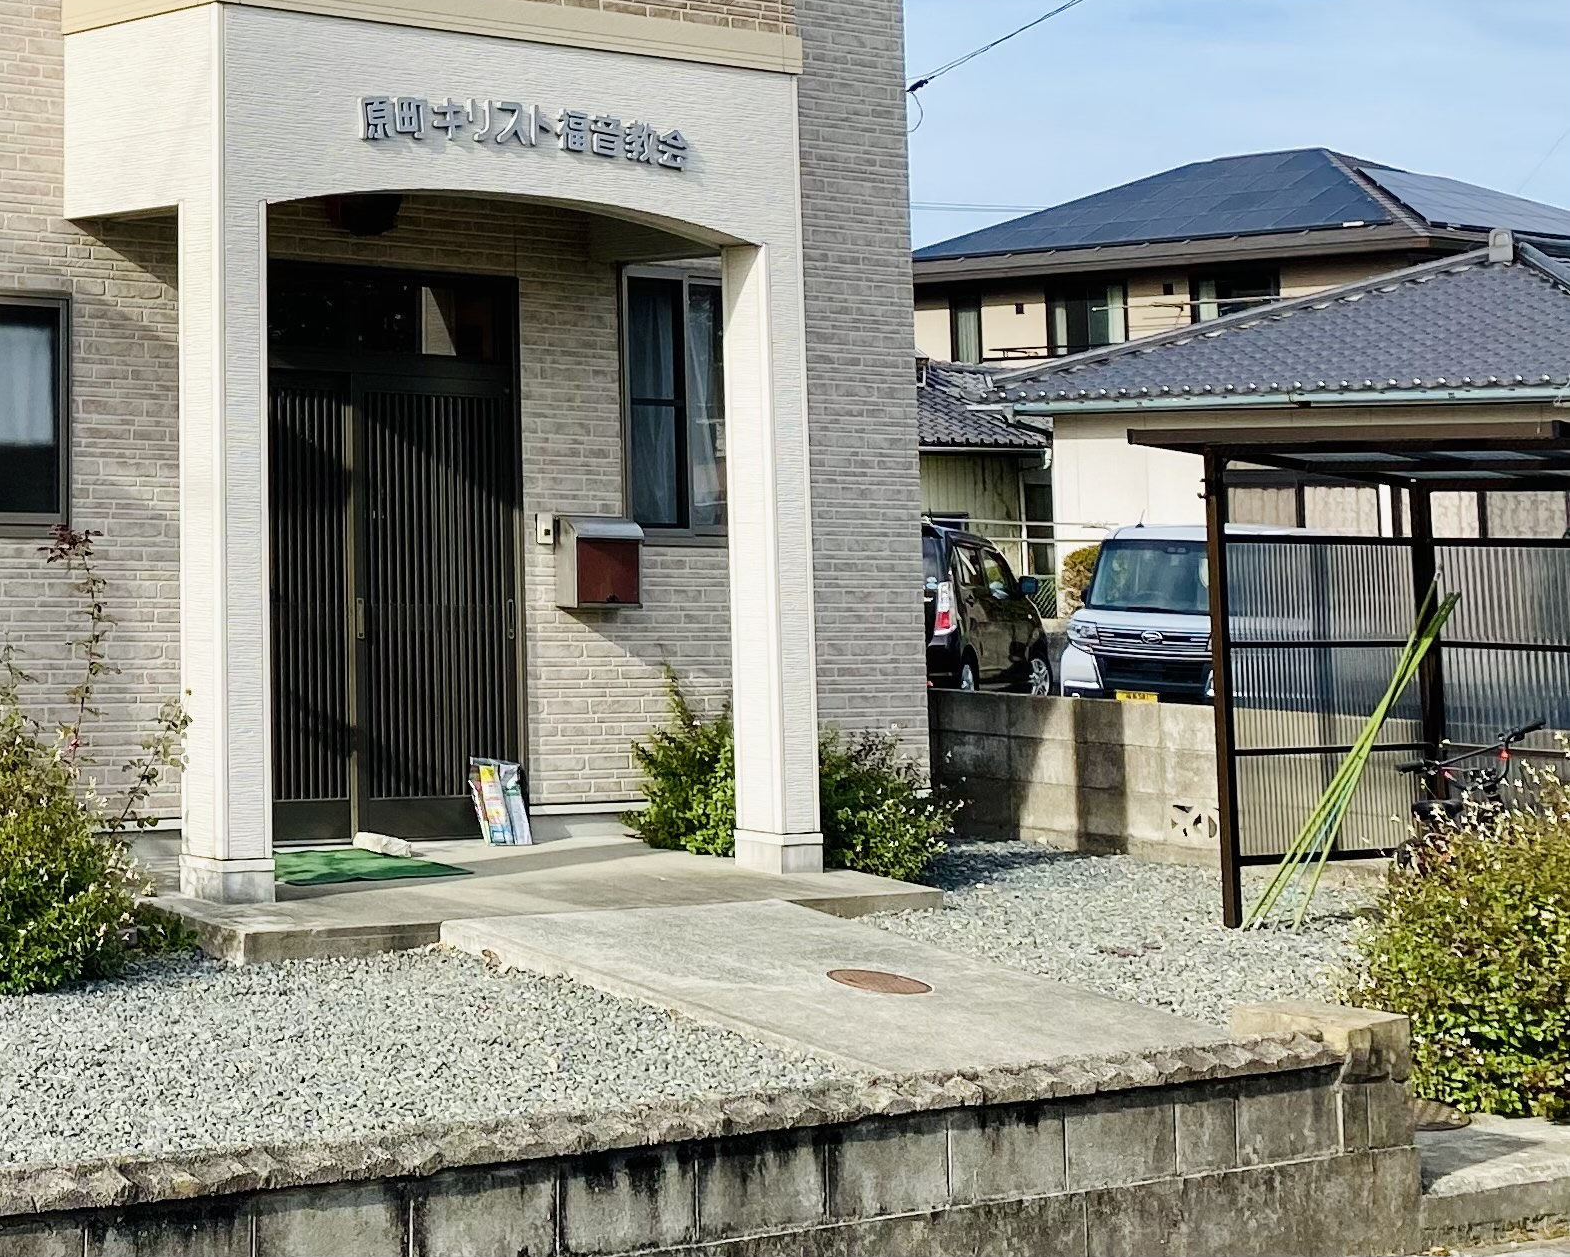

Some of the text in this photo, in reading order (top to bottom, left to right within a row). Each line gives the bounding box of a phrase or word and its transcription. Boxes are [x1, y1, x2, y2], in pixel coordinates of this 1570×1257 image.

[357, 96, 687, 171] 原町キリスト福音教会
